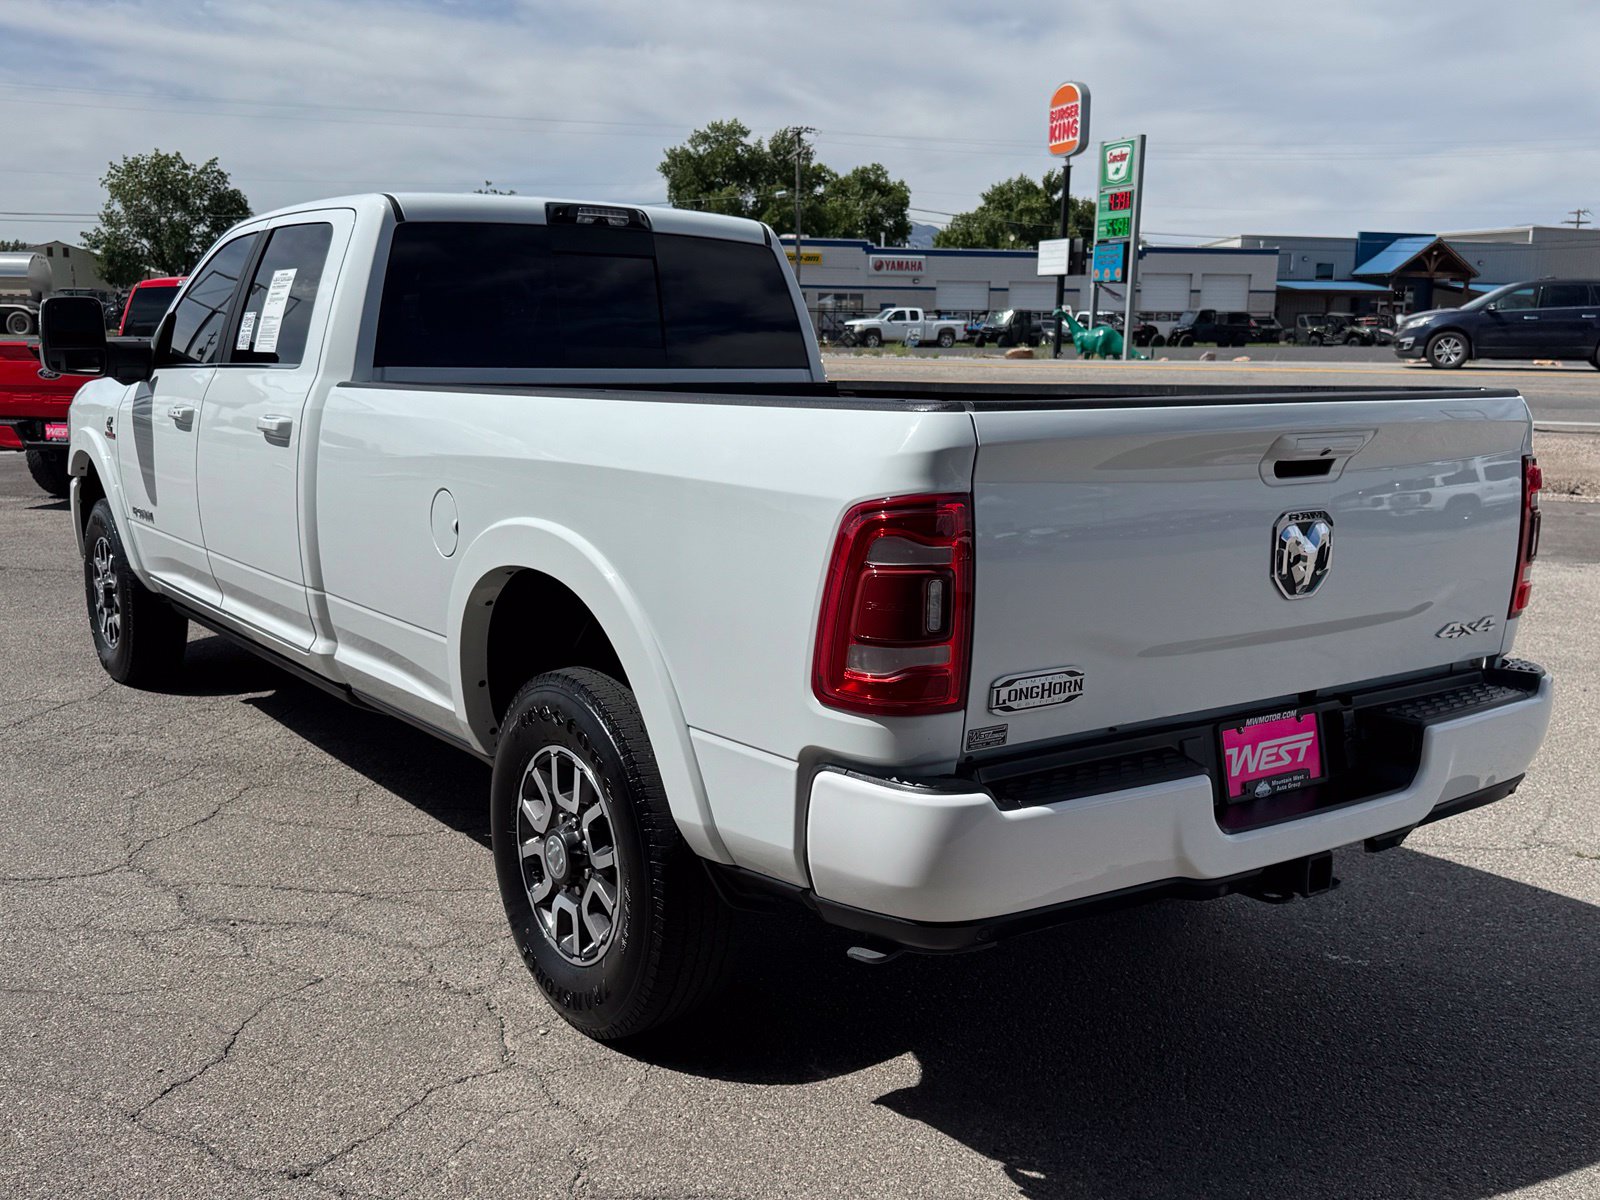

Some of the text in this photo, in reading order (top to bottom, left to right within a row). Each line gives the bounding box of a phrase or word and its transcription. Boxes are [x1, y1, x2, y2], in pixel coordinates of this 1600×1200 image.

[1049, 103, 1079, 124] BURGER
[1049, 118, 1078, 143] KING
[885, 260, 923, 272] YAMAHA
[1288, 512, 1323, 521] RAM
[1018, 675, 1064, 686] LIMITED
[1246, 710, 1297, 726] MWMOTOR.COM
[1226, 731, 1315, 777] WEST
[1271, 777, 1292, 786] Mountain
